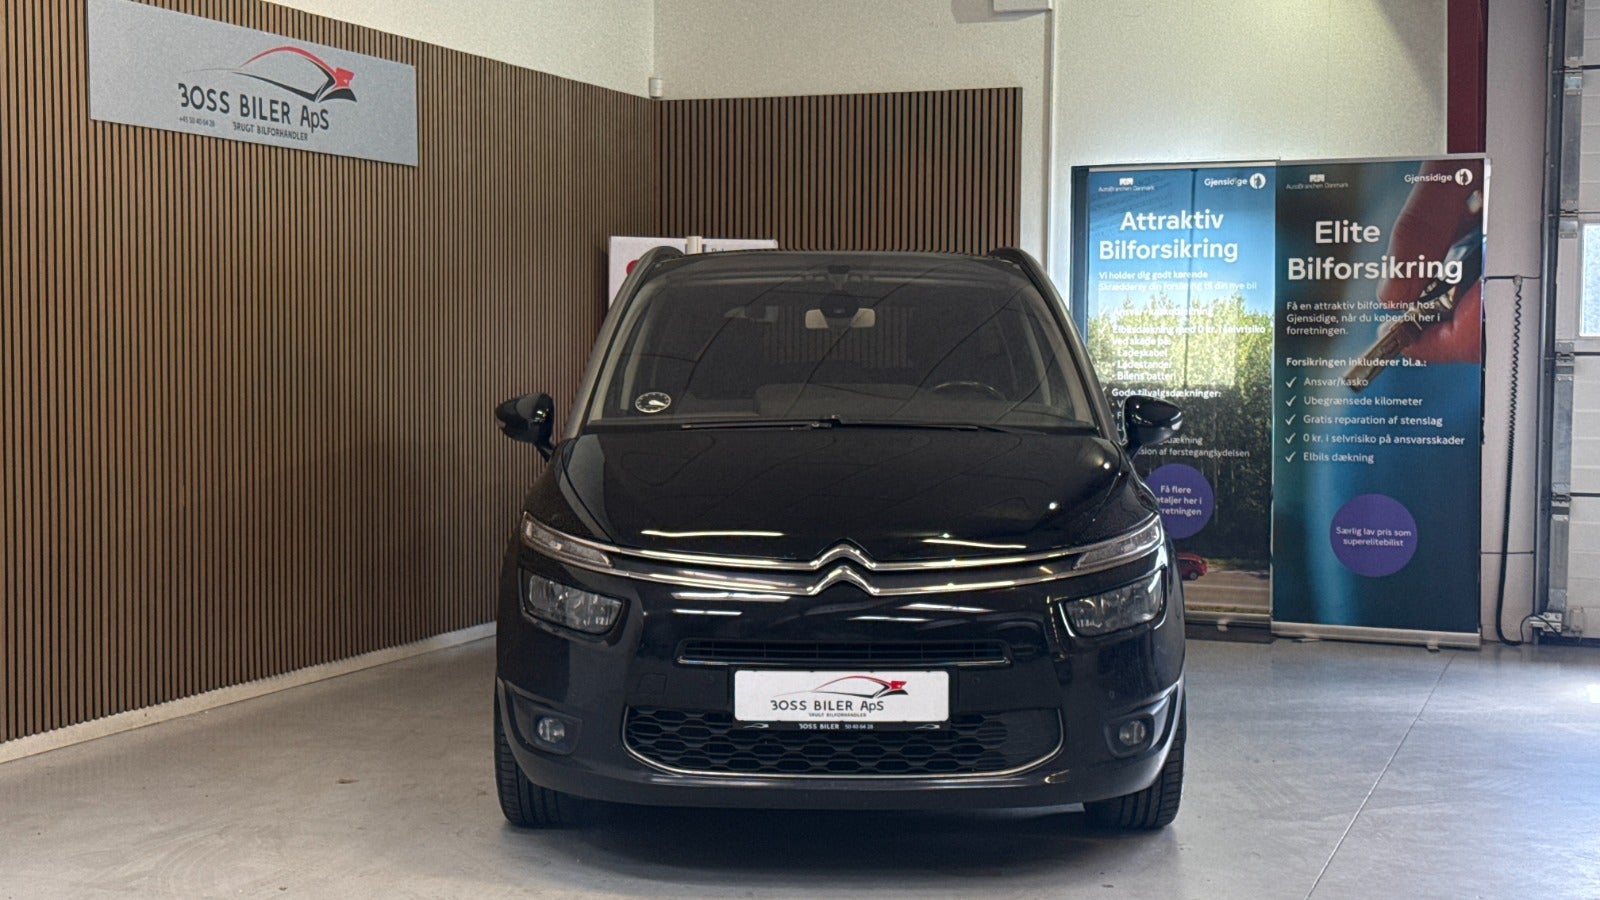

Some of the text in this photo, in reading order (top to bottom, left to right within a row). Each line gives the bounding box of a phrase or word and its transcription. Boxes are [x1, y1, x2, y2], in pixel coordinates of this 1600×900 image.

[239, 94, 291, 125] BILER
[300, 104, 330, 133] ApS
[256, 125, 308, 142] BILFORHANDLER
[1204, 176, 1248, 188] Gjensidige
[1404, 173, 1452, 183] Gjensidige
[1120, 208, 1224, 231] Attraktiv
[1315, 219, 1380, 244] Elite
[1099, 238, 1238, 263] Bilforsikring
[1288, 254, 1462, 284] Bilforsikring
[1099, 270, 1208, 281] Vi holder dig godt kørende
[1214, 281, 1228, 290] din
[1229, 283, 1245, 292] nye
[1246, 281, 1257, 289] bil
[1286, 301, 1298, 311] Få
[1313, 301, 1355, 310] attraktiv
[1357, 300, 1414, 311] bilforsikring
[1416, 301, 1435, 310] hos
[1286, 313, 1339, 325] Gjensidige,
[1341, 312, 1358, 322] når
[1359, 313, 1372, 322] du
[1374, 313, 1401, 322] køber
[1418, 313, 1435, 322] her
[1223, 325, 1266, 333] selvrisiko
[1286, 326, 1349, 336] forretningen.
[1129, 336, 1156, 345] skade
[1117, 361, 1172, 369] Ladestander
[1286, 357, 1346, 368] Forsikringen
[1349, 357, 1400, 367] inkluderer
[1117, 371, 1145, 380] Bilens
[1303, 377, 1369, 387] Ansvar/kasko
[1111, 388, 1136, 397] Gode
[1303, 396, 1423, 407] Ubegrænsede kilometer
[1303, 414, 1443, 427] Gratis reparation af stenslag
[1303, 433, 1309, 442] 0
[1312, 433, 1323, 442] kr.
[1331, 433, 1377, 443] selvrisiko
[1379, 434, 1392, 446] på
[1393, 435, 1465, 445] ansvarsskader
[1303, 452, 1375, 464] Elbils dækning
[1160, 485, 1192, 494] Få flere
[1157, 497, 1182, 506] etaljer
[1183, 497, 1197, 505] her
[1336, 526, 1412, 537] Særlig lav pris som
[1343, 537, 1404, 547] superelitebilist
[814, 700, 853, 711] BILER
[860, 700, 884, 713] ApS
